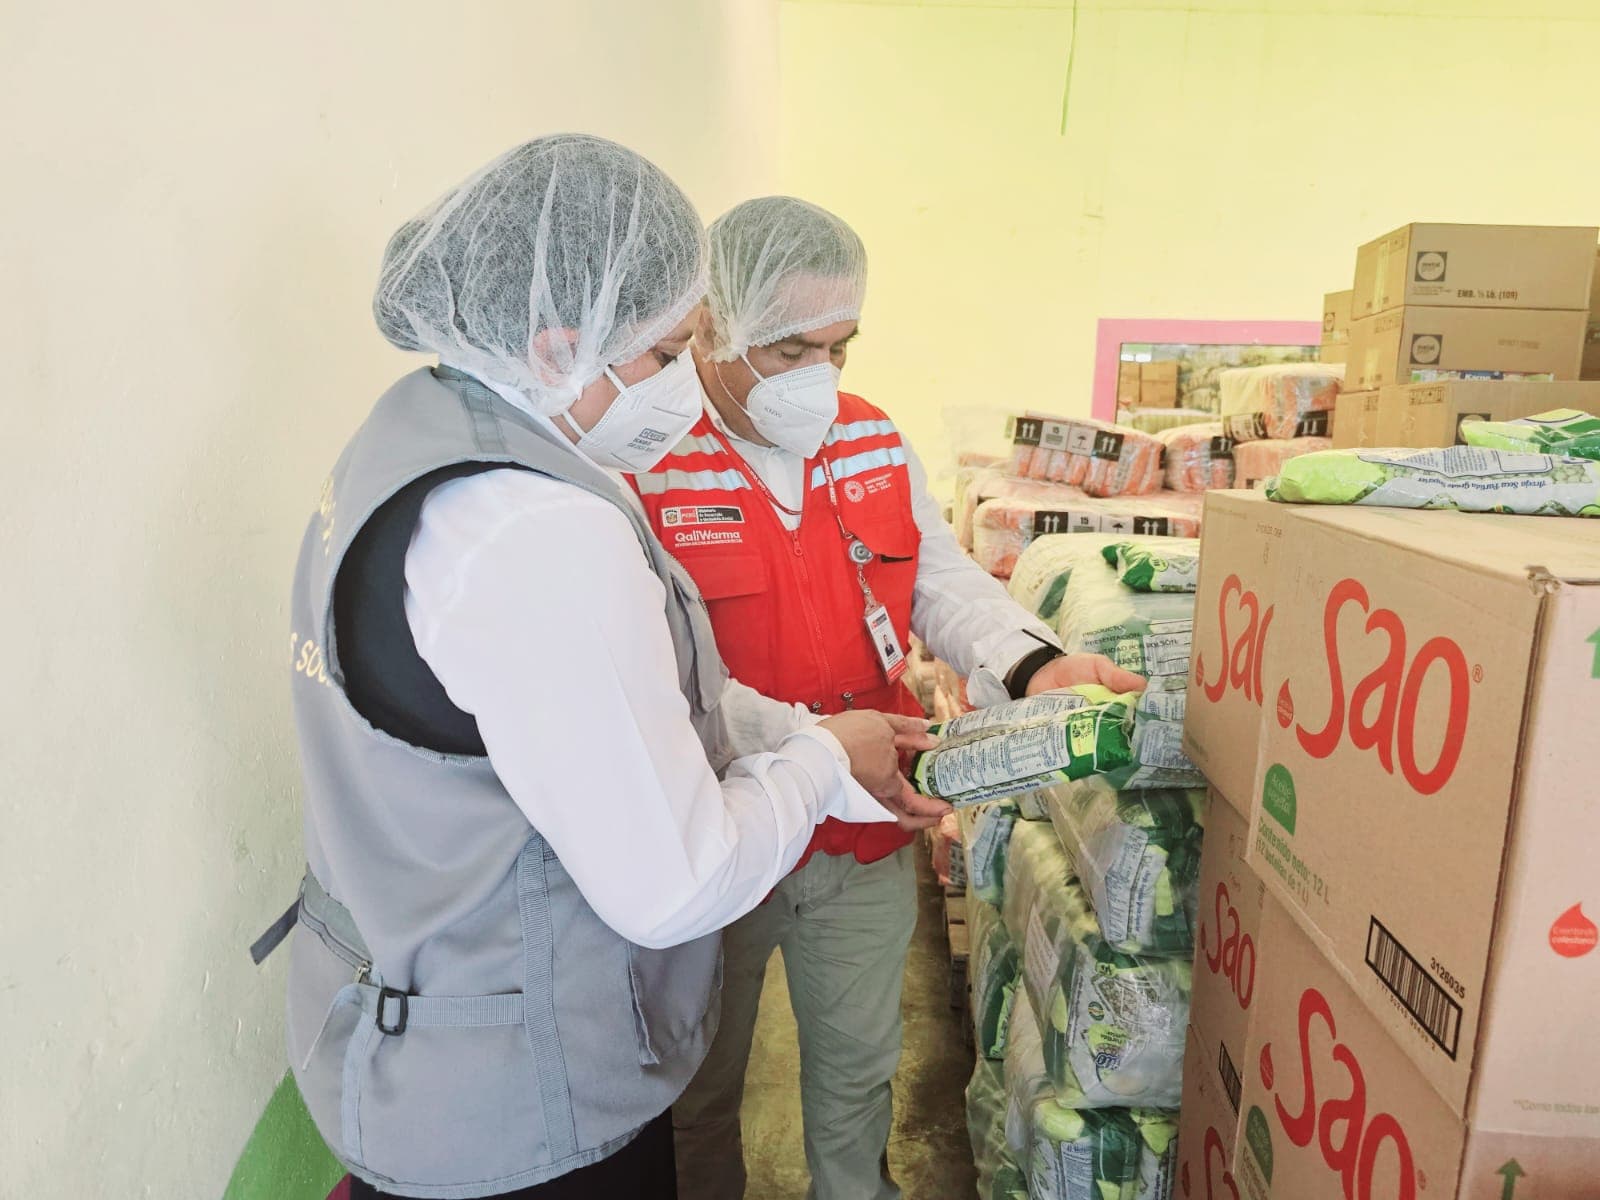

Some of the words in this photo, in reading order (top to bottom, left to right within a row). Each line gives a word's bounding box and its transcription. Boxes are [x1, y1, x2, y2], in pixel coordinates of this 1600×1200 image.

[675, 530, 741, 543] QaliWarma
[1296, 578, 1470, 795] Sao
[1205, 882, 1255, 1010] Sao
